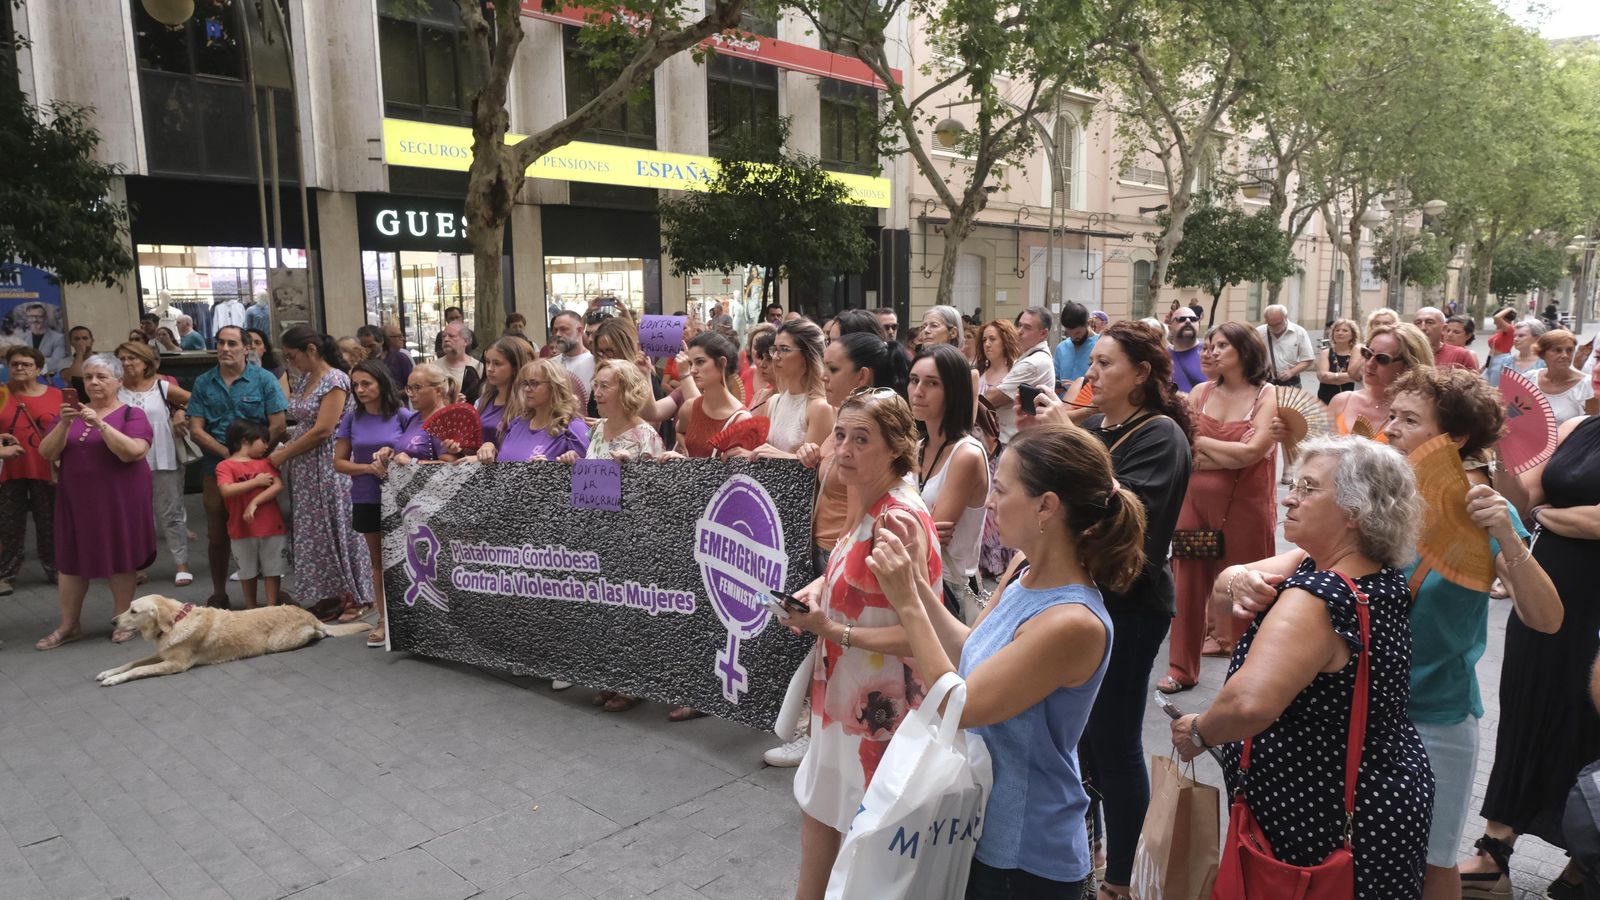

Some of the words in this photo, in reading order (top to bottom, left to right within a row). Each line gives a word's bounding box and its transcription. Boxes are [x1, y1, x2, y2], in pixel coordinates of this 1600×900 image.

[399, 140, 468, 159] SEGUROS
[543, 156, 610, 173] PENSIONES
[636, 159, 710, 182] ESPAÑA
[848, 187, 886, 200] ENSIONES
[640, 319, 682, 330] CONTRA
[650, 331, 665, 340] LA
[573, 463, 618, 477] CONTRA
[451, 541, 519, 565] Plataforma
[522, 545, 598, 570] Cordobesa
[700, 528, 782, 592] EMERGENCIA
[453, 568, 497, 592] Contra
[500, 572, 512, 593] la
[514, 574, 585, 599] Violencia
[588, 583, 599, 601] a
[600, 580, 623, 603] las
[626, 583, 694, 613] Mujeres
[720, 576, 758, 612] FEMINISTA
